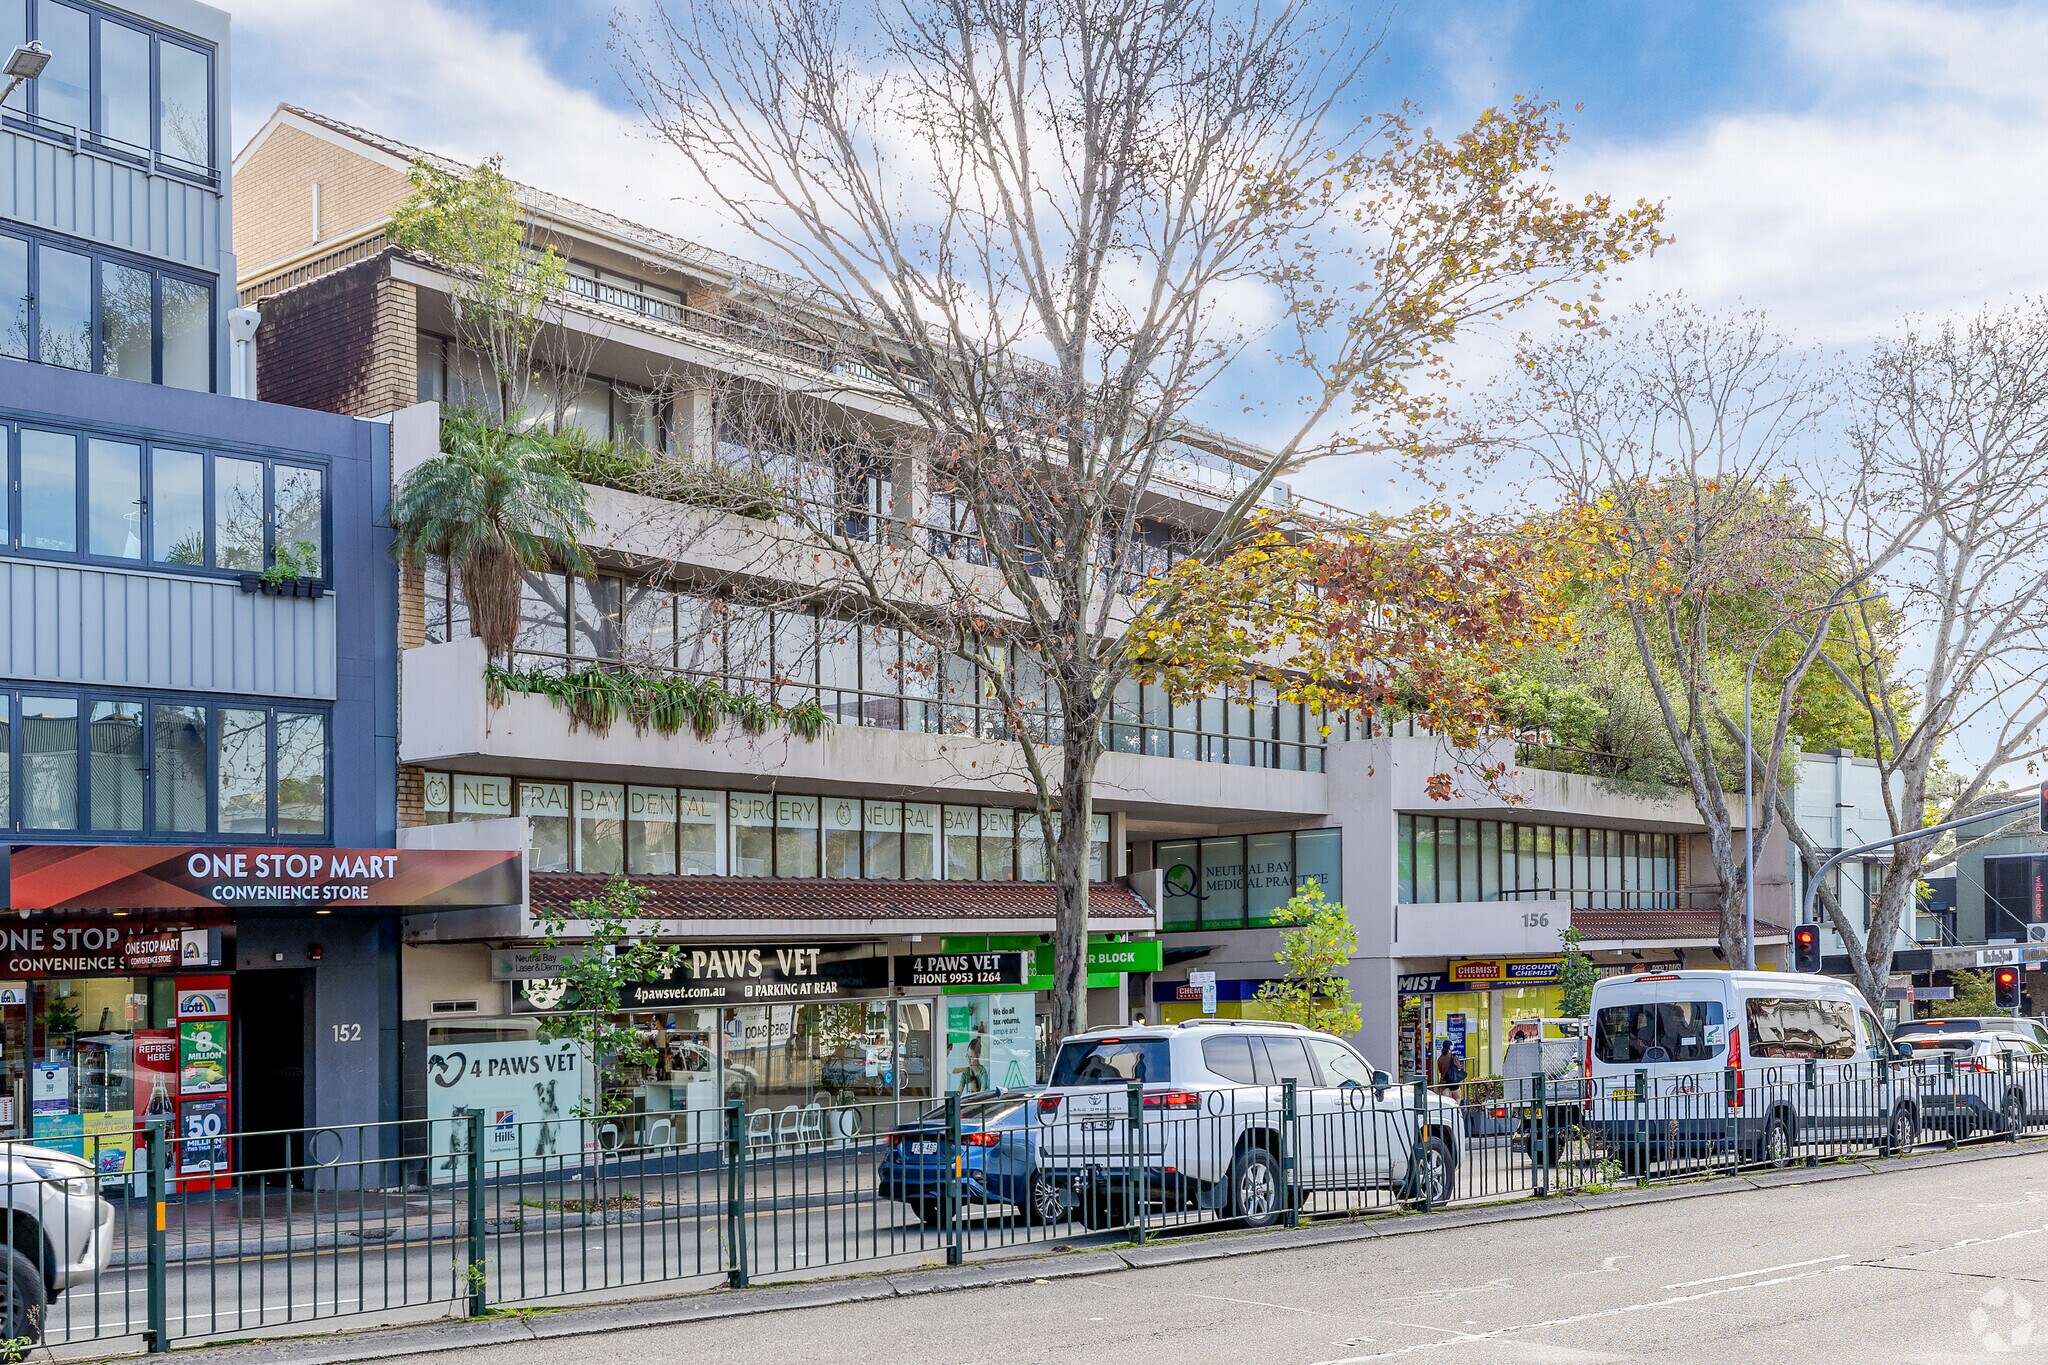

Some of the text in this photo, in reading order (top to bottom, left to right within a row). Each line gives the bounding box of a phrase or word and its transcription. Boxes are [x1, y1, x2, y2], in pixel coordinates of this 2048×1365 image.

[463, 782, 815, 822] NEUTRAL BAY DENTAL SURGERY
[945, 810, 973, 829] BAY
[187, 853, 398, 879] ONE STOP MART
[1206, 861, 1292, 877] NEUTRAL BAY
[1206, 873, 1329, 891] MEDICAL PRACTICE
[212, 885, 369, 900] CONVENIENCE STORE
[2035, 875, 2044, 919] wild ember
[1521, 912, 1549, 927] 156
[53, 927, 120, 951] STOP
[125, 938, 180, 955] ONE STOP MART
[9, 956, 116, 972] CONVENIENCE
[130, 956, 158, 966] CONVENIENCE
[158, 954, 172, 964] STORE
[515, 953, 557, 964] Neutral Bay
[692, 949, 762, 979] PAWS
[775, 948, 820, 977] VET
[913, 954, 1001, 972] 4 PAWS VET
[1100, 952, 1135, 963] BLOCK
[515, 964, 534, 972] Laser
[1458, 965, 1498, 975] CHEMIST
[1511, 963, 1558, 971] DISCOUNT
[1600, 966, 1625, 979] HEMIST
[913, 972, 1001, 984] PHONE 9953 1264
[1399, 976, 1440, 991] MIST
[634, 986, 726, 1001] 4pawsvet.com.au
[755, 982, 798, 998] PARKING
[800, 982, 814, 995] AT
[814, 981, 838, 994] REAR
[332, 1023, 361, 1042] 152
[1009, 1026, 1018, 1034] and
[147, 1053, 170, 1061] HERE
[188, 1052, 222, 1060] MILLION
[470, 1053, 576, 1078] 4 PAWS VET
[185, 1113, 221, 1138] $50
[494, 1131, 516, 1143] Hill's
